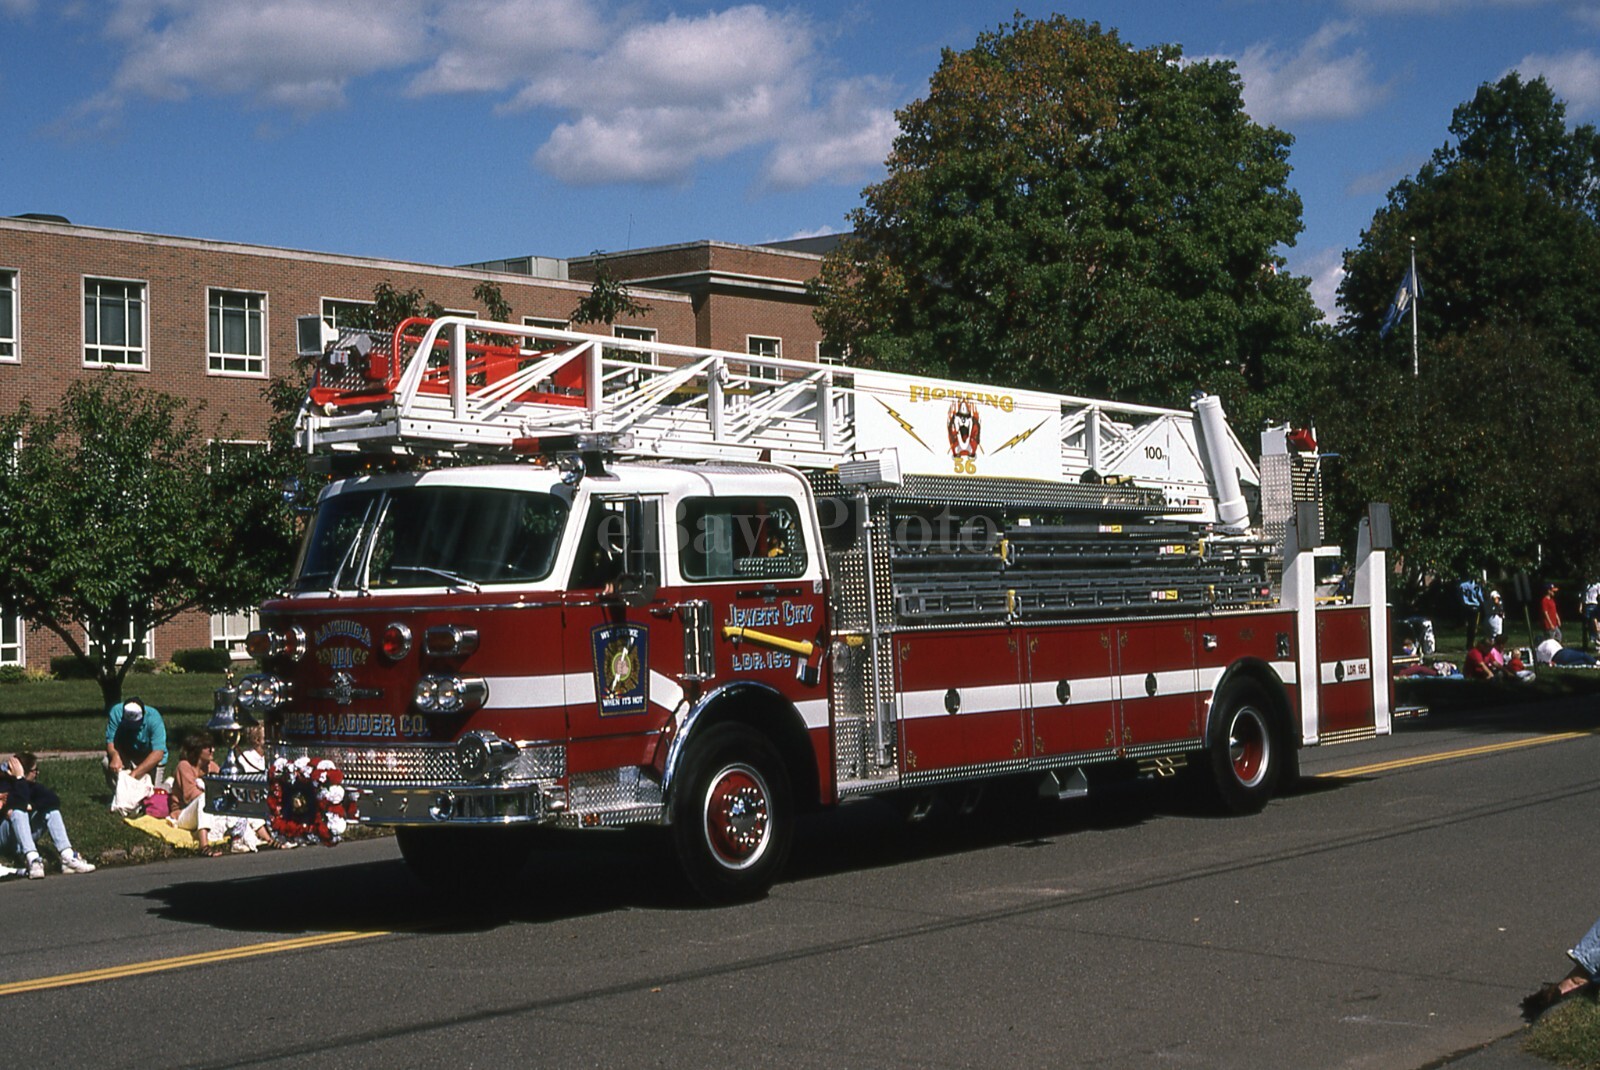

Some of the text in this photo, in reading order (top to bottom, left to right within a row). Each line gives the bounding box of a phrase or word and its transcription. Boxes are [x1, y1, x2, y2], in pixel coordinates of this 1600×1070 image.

[909, 385, 1014, 413] FIGHTING
[1144, 446, 1162, 460] 100
[953, 457, 977, 474] 56
[1346, 664, 1357, 676] LDR
[602, 698, 620, 707] WHEN
[632, 695, 644, 705] HOT
[317, 714, 328, 736] &
[328, 712, 397, 737] LADDER
